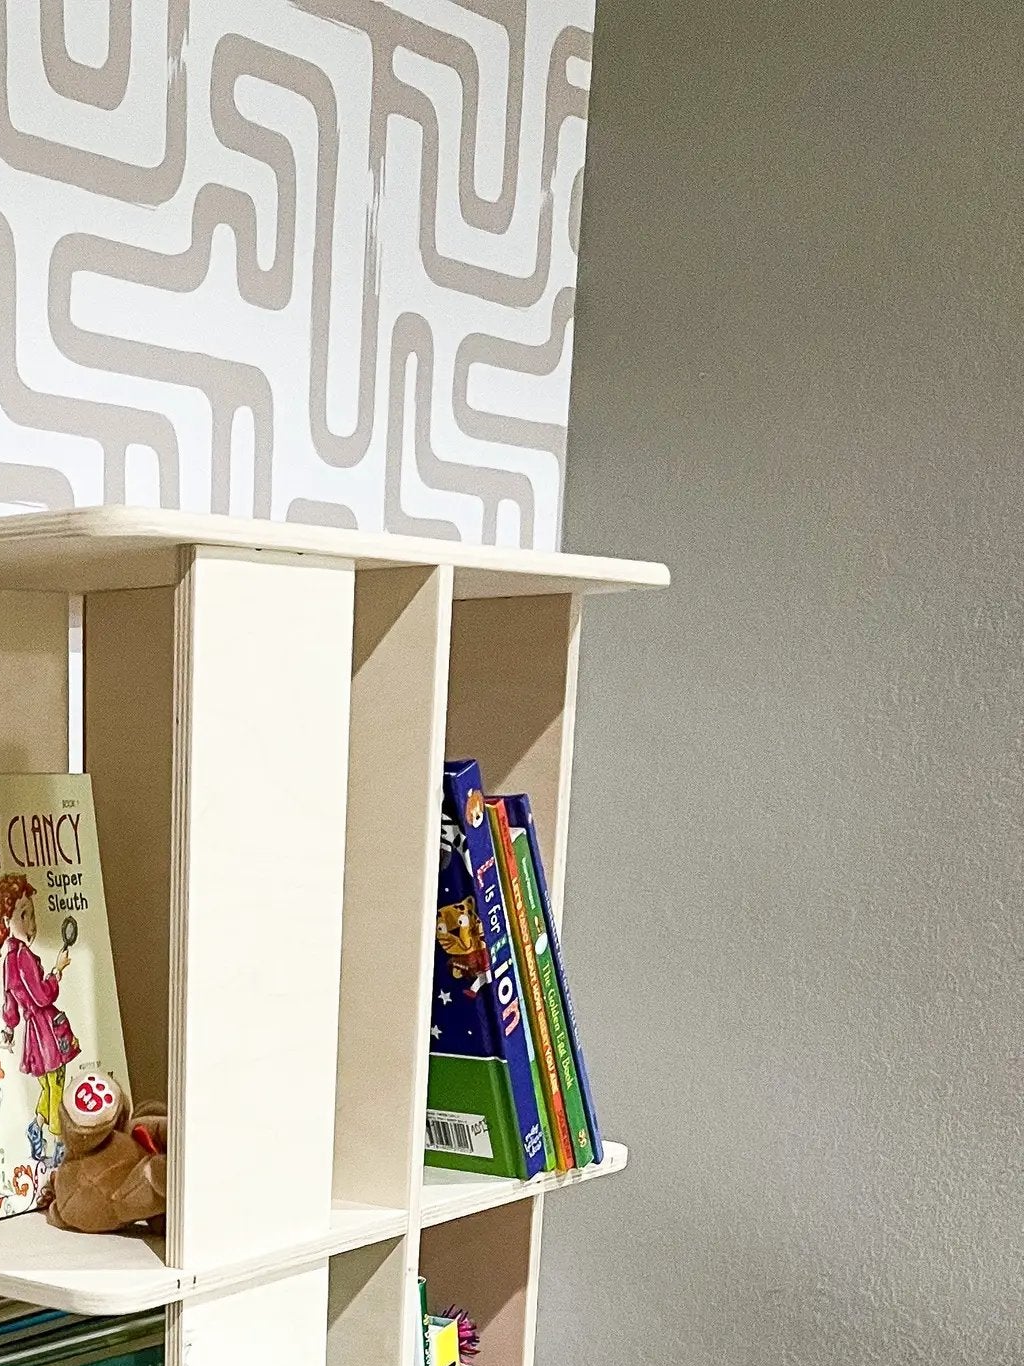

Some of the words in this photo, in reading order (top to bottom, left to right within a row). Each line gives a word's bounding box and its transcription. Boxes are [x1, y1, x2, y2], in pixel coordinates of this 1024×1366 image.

[8, 813, 81, 868] CLANCY
[46, 871, 83, 894] Super
[476, 856, 495, 889] L
[48, 892, 88, 912] Sleuth
[487, 904, 502, 934] for
[491, 933, 521, 1037] Lion
[541, 960, 552, 986] The
[547, 988, 562, 1032] Golden
[561, 1058, 573, 1091] Book
